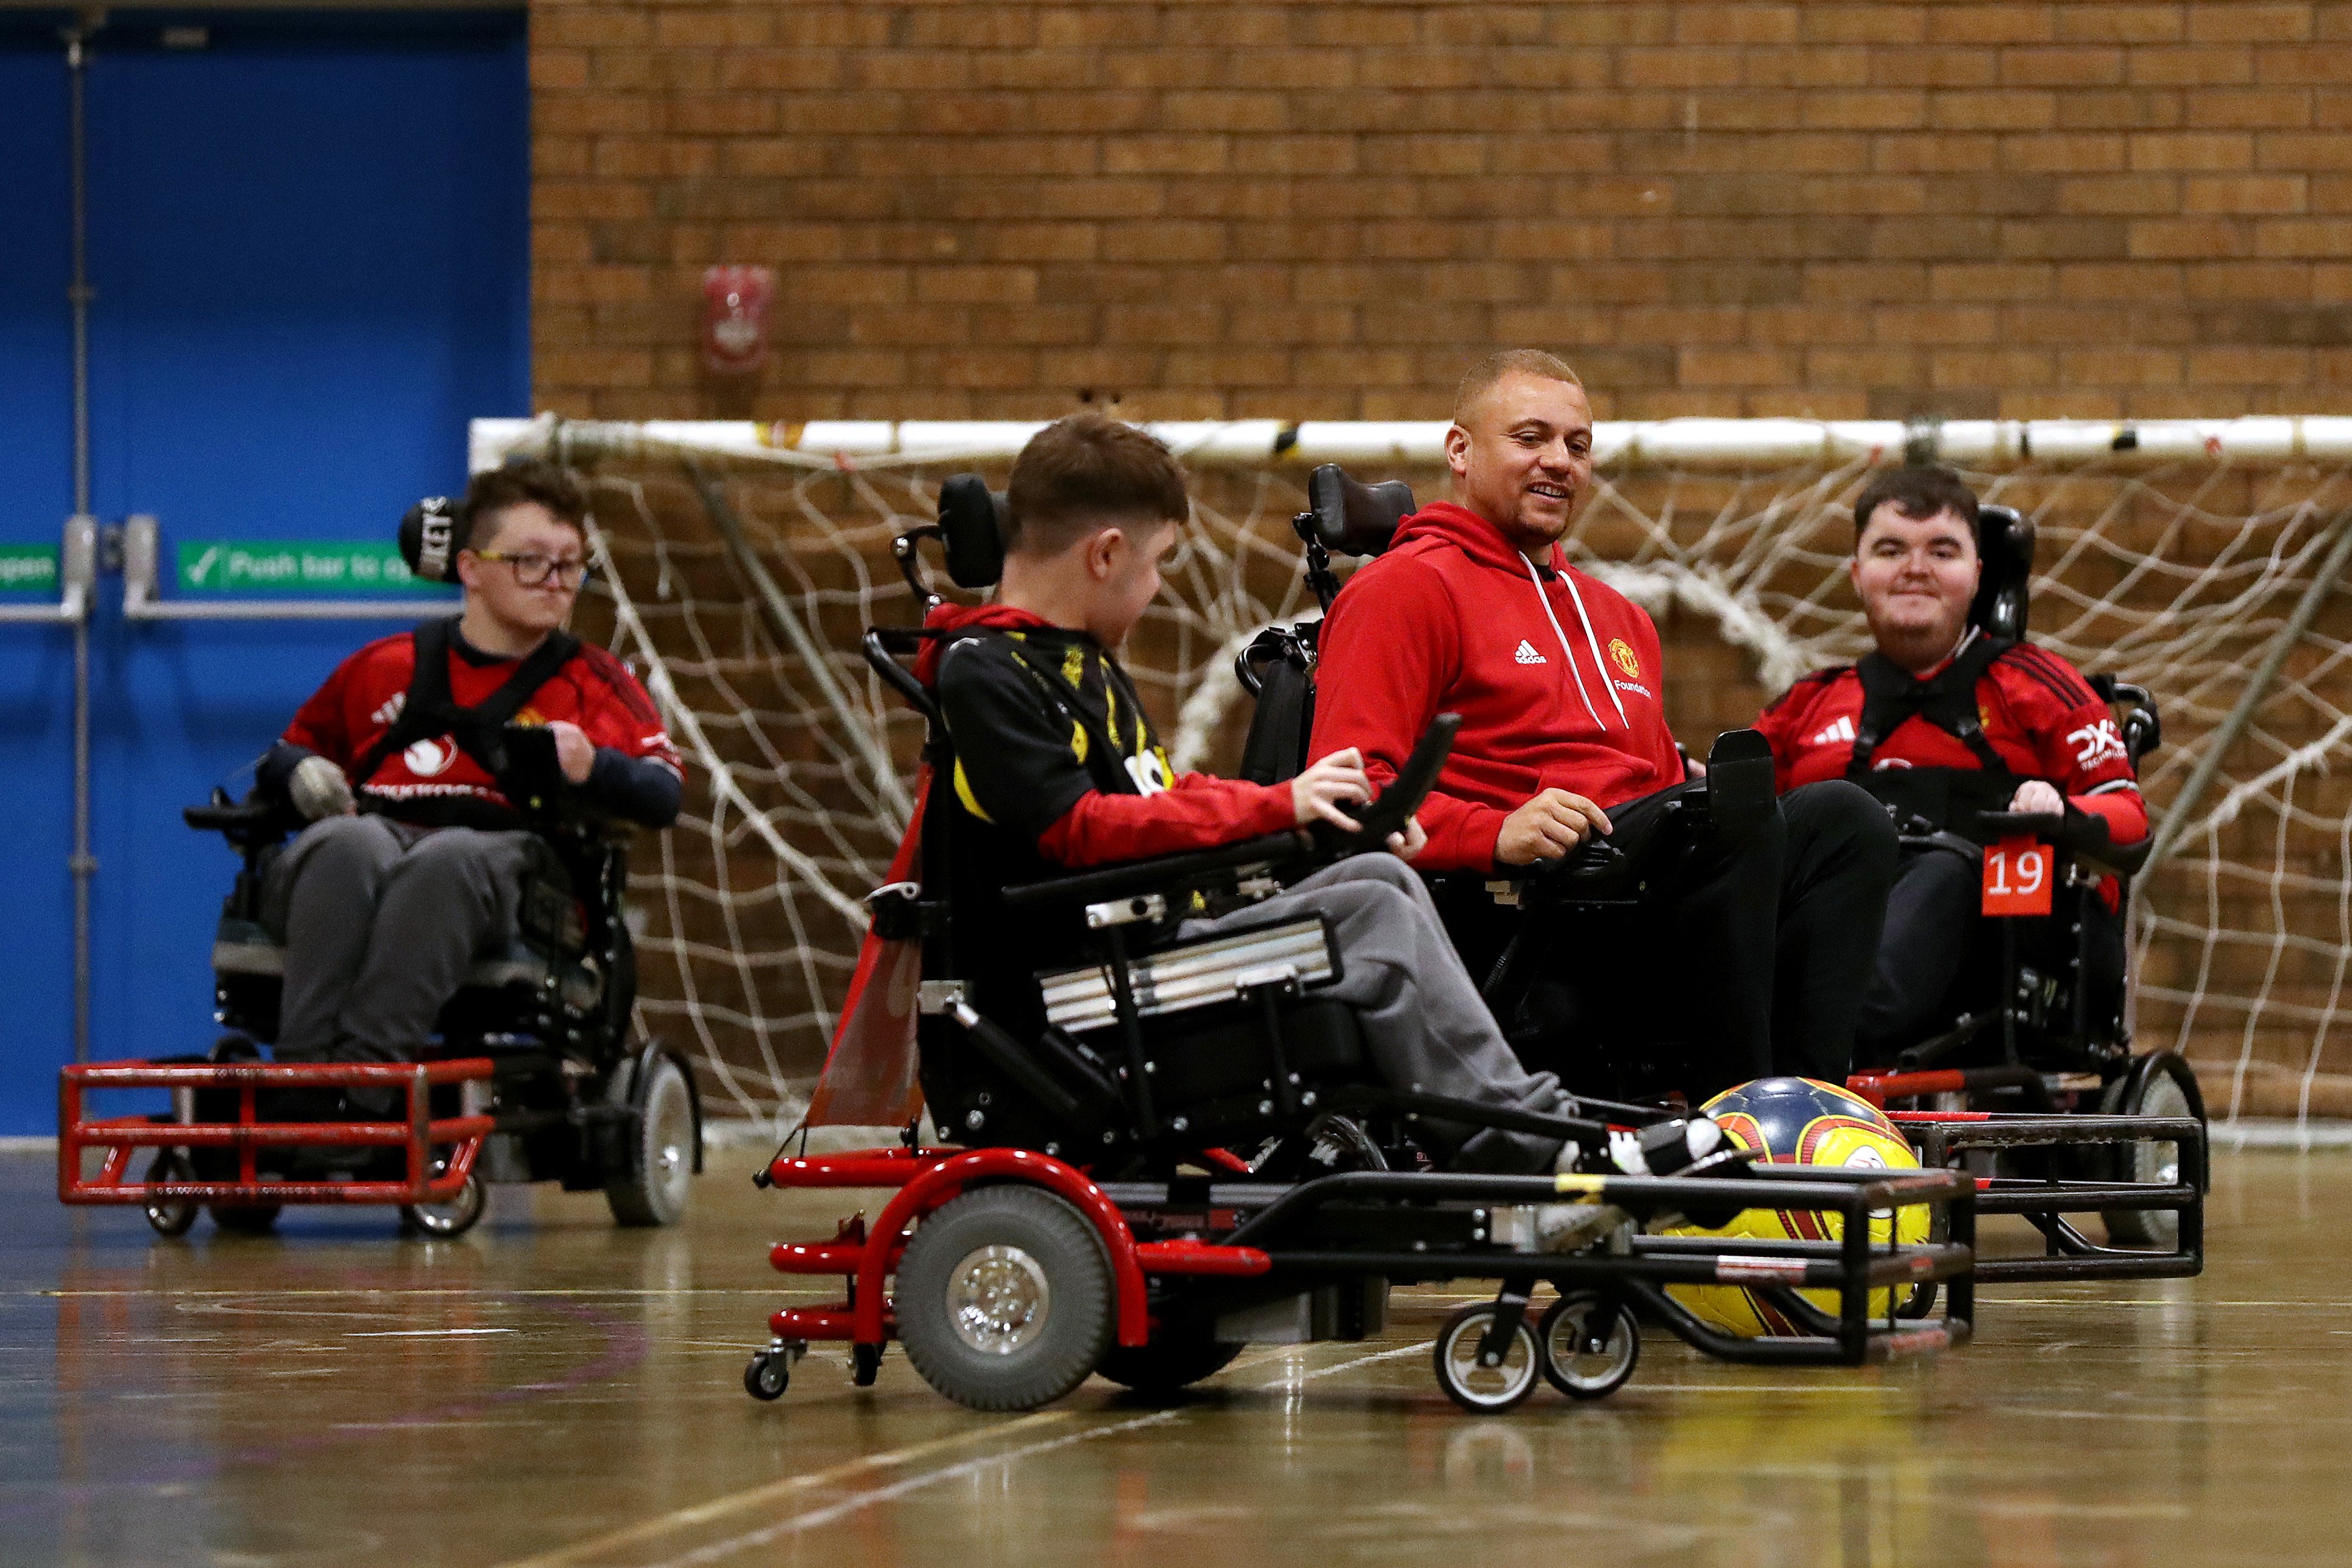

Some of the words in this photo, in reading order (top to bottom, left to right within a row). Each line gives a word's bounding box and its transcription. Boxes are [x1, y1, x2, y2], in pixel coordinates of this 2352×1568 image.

[229, 552, 297, 578] Push
[302, 554, 345, 579] bar
[351, 555, 379, 579] to
[1515, 655, 1547, 664] adidas
[1987, 851, 2044, 895] 19
